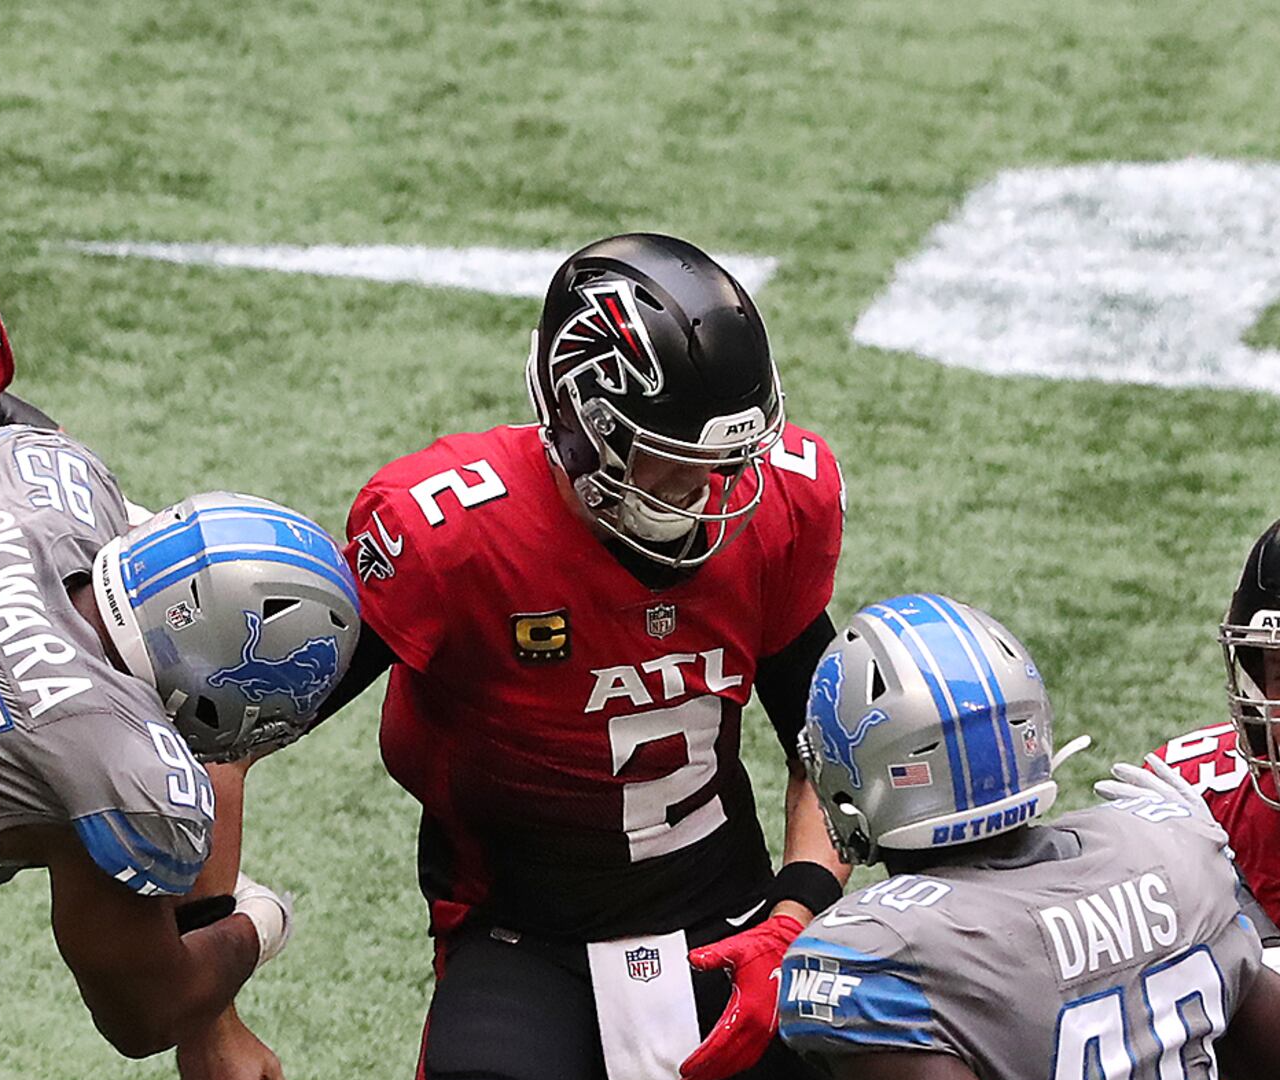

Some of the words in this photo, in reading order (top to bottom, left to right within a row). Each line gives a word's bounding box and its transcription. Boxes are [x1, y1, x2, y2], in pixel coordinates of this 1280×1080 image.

[725, 419, 757, 438] ATL
[409, 459, 510, 527] 2
[516, 615, 567, 650] C
[585, 647, 744, 713] ATL
[607, 695, 728, 863] 2
[932, 798, 1040, 845] DETROIT
[1039, 871, 1180, 982] DAVIS
[787, 968, 863, 1008] WCF
